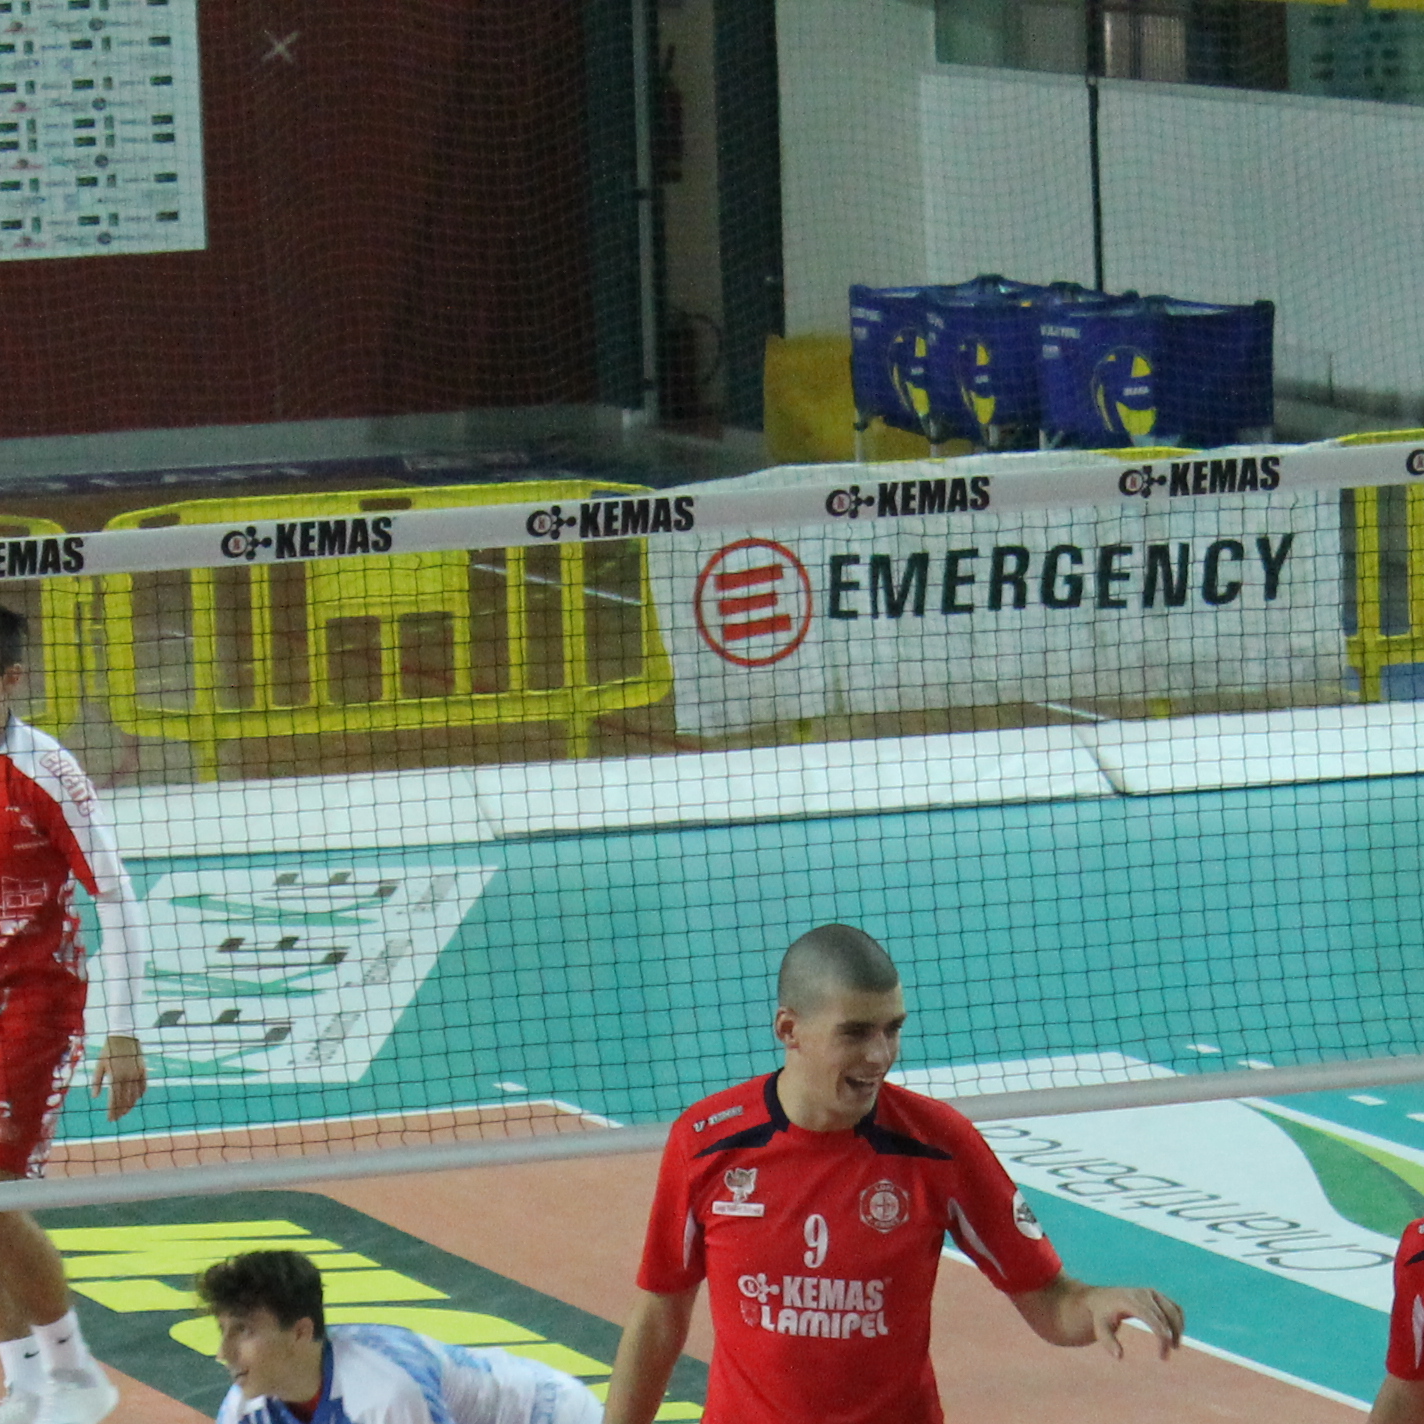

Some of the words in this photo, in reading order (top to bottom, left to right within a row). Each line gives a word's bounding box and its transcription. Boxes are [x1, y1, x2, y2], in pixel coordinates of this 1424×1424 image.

[1170, 457, 1280, 496] KEMAS
[878, 477, 990, 517] KEMAS
[579, 498, 694, 536] KEMAS
[275, 517, 393, 557] KEMAS
[828, 533, 1293, 619] EMERGENCY
[803, 1213, 829, 1269] 9
[782, 1275, 884, 1312] KEMAS
[761, 1305, 889, 1340] LAMIPEL
